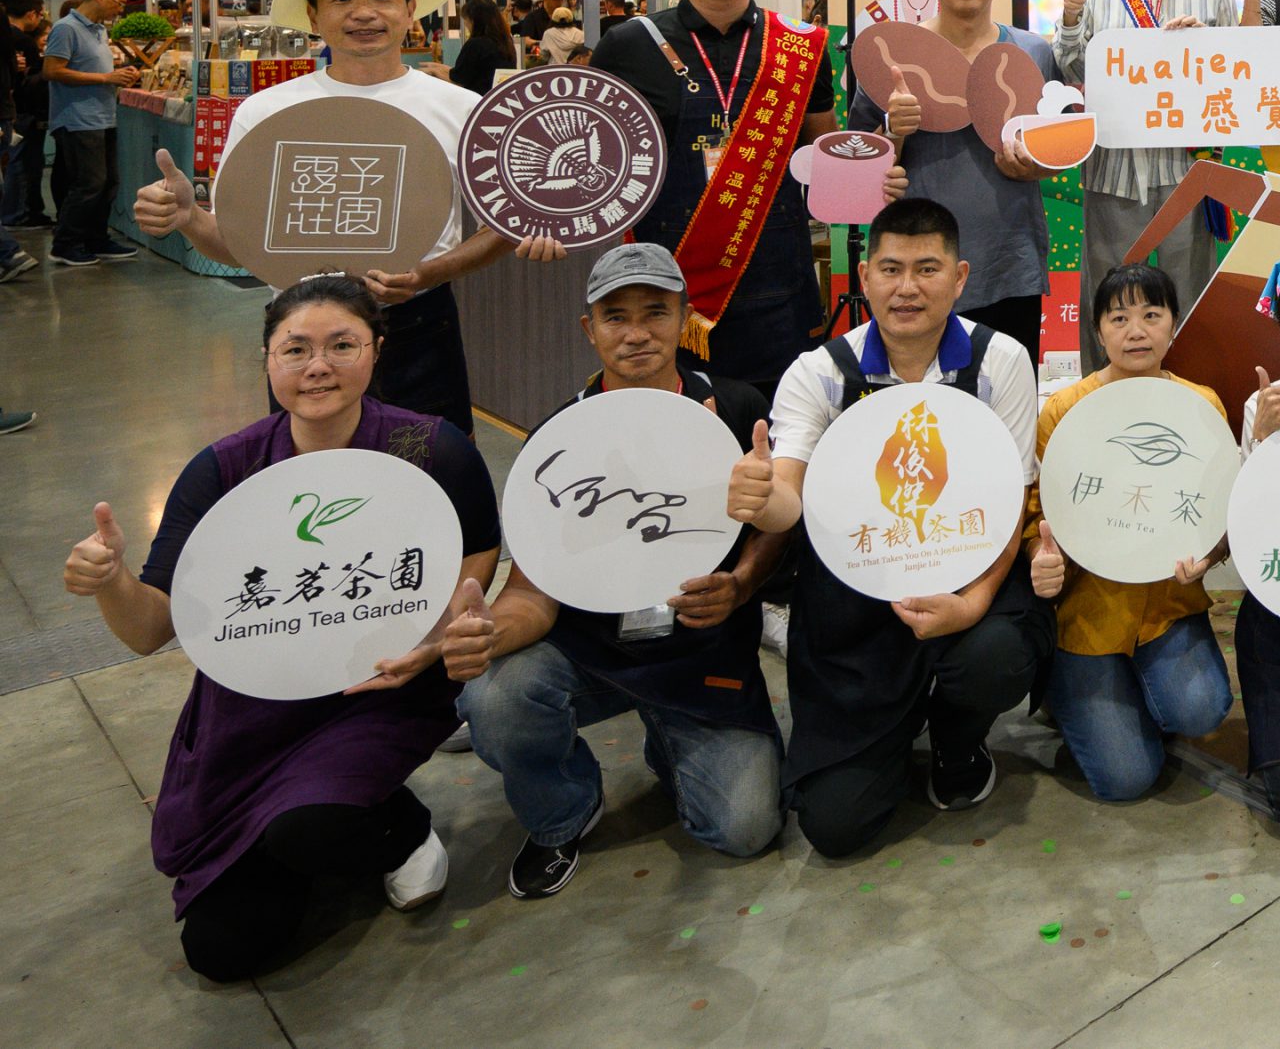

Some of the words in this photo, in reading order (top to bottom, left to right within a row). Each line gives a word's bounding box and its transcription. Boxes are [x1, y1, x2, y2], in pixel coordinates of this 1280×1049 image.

[783, 32, 811, 47] 2024
[771, 52, 789, 84] 精選
[1106, 48, 1252, 84] Hualien
[738, 89, 779, 163] 馬耀咖啡
[1060, 303, 1079, 322] 花
[1068, 472, 1206, 526] 伊禾茶
[849, 508, 986, 554] 有機茶園
[1106, 517, 1131, 529] Yihe
[1133, 522, 1155, 533] Tea
[862, 559, 880, 567] That
[882, 555, 903, 564] Takes
[905, 552, 920, 560] You
[929, 559, 941, 567] Lin
[224, 548, 424, 620] 嘉茗茶園
[214, 618, 301, 642] Jiaming
[309, 610, 345, 627] Tea
[353, 599, 428, 621] Garden
